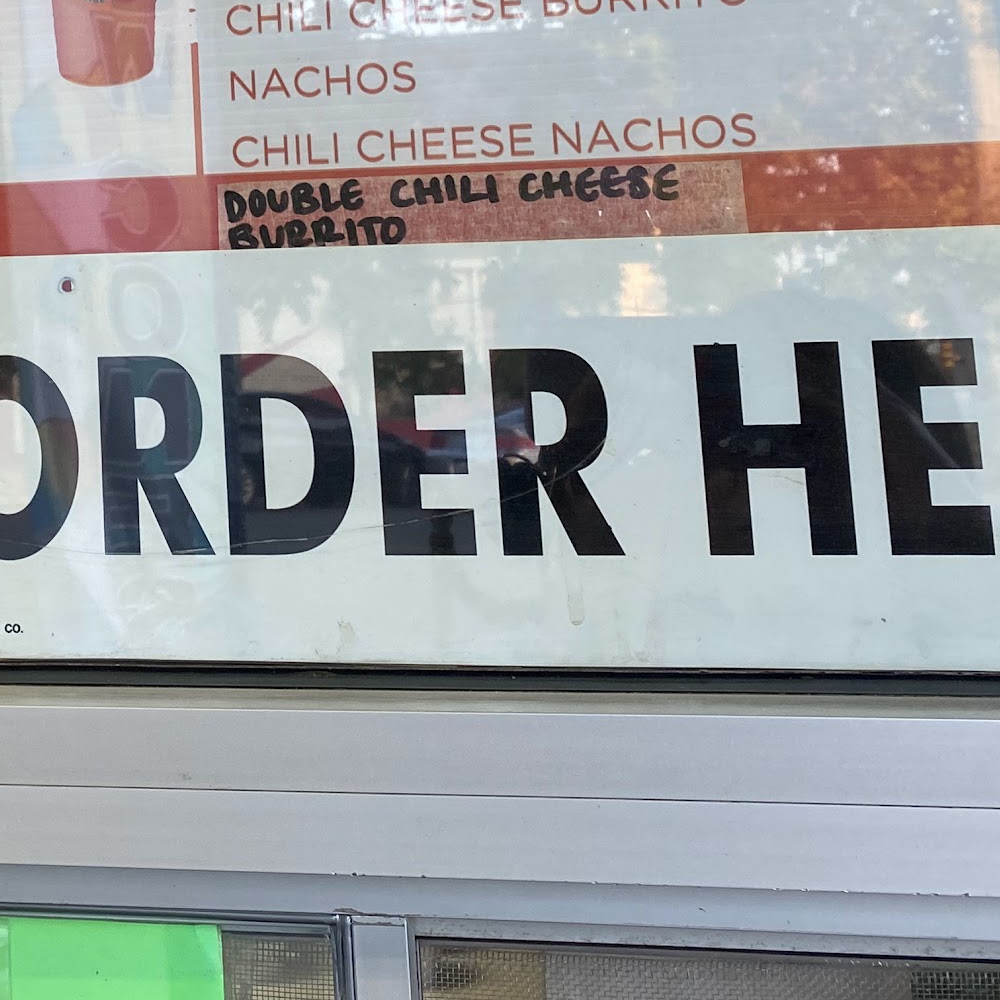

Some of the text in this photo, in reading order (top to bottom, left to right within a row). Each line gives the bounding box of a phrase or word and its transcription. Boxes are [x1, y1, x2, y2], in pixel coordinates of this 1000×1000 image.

[225, 0, 333, 37] CHILI
[229, 60, 418, 102] NACHOS
[231, 113, 758, 168] CHILI CHEESE NACHOS
[223, 163, 680, 223] DOUBLE CHILI CHEESE
[227, 215, 407, 249] BURRITO
[692, 337, 996, 556] HE
[4, 623, 24, 634] CO.
